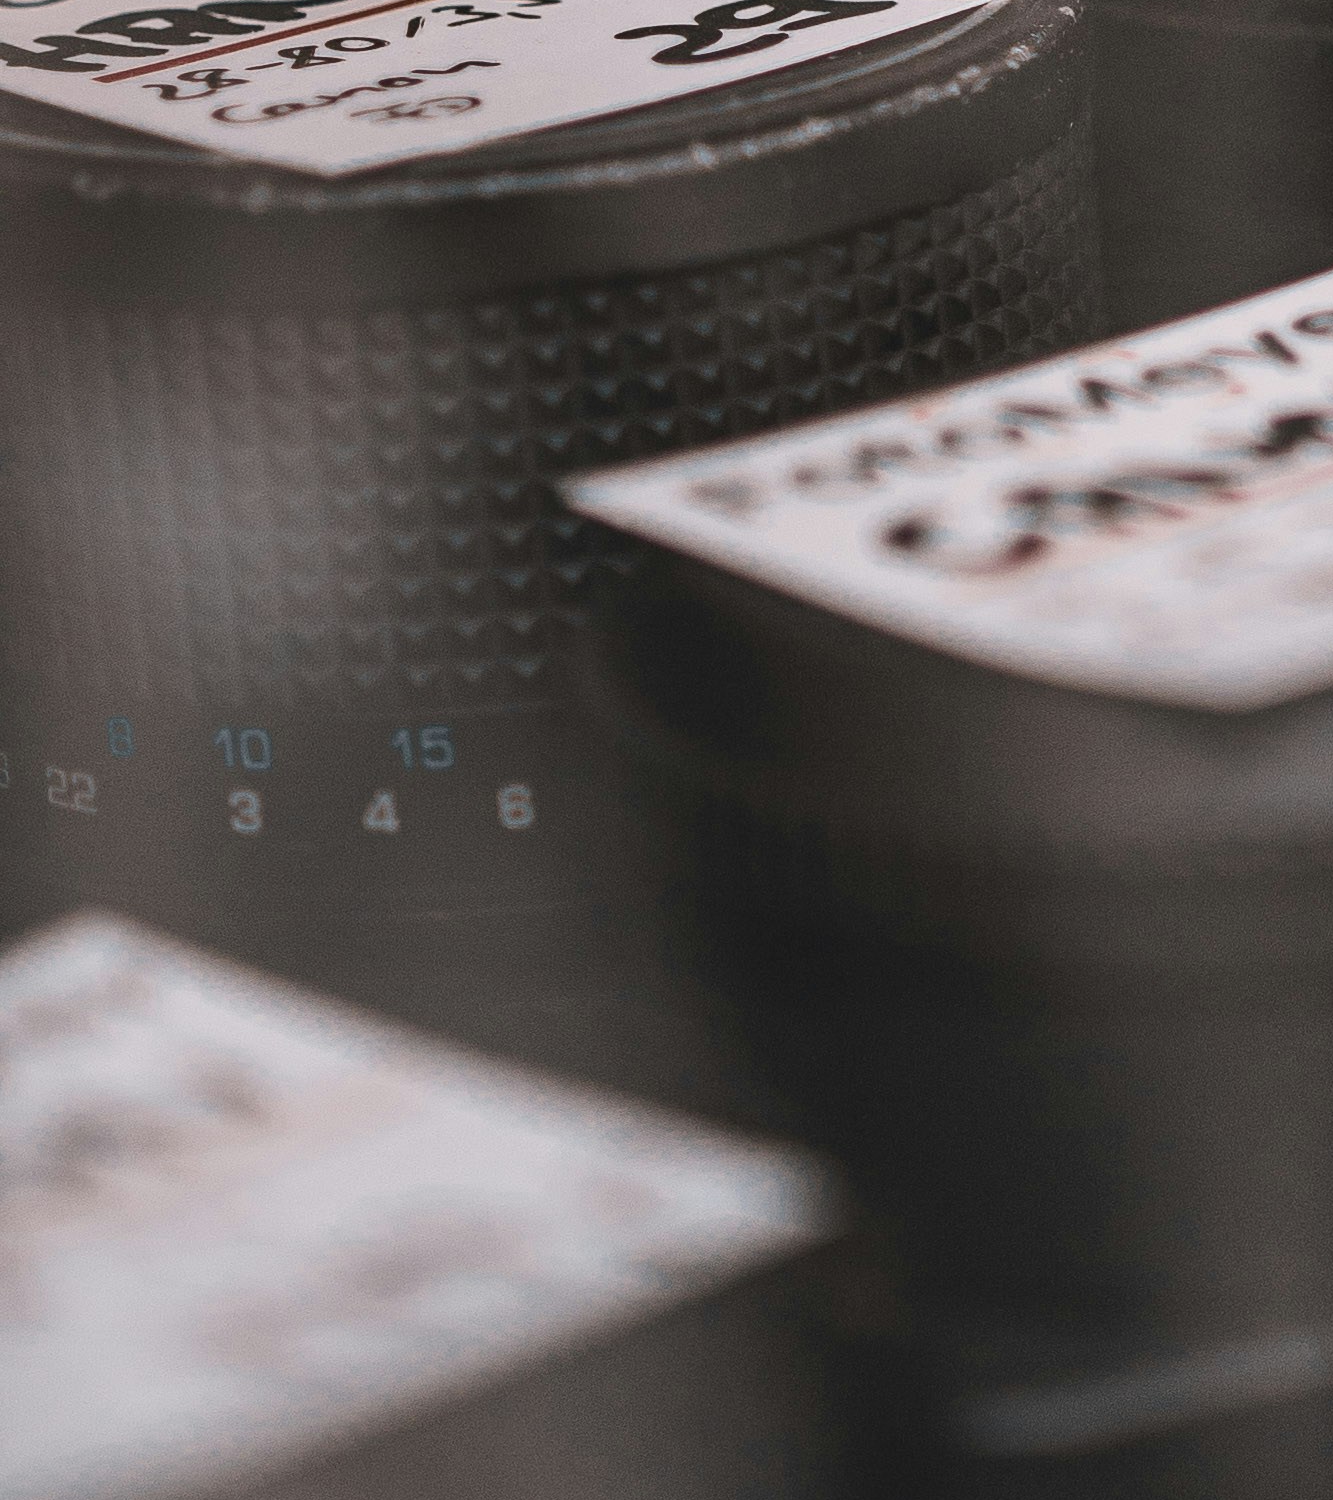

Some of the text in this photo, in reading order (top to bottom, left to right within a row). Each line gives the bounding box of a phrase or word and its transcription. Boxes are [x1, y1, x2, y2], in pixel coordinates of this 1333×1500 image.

[210, 60, 502, 124] Canon
[214, 727, 272, 770] 10
[391, 725, 455, 769] 15
[46, 765, 98, 816] 22
[229, 790, 262, 833] 3
[363, 790, 399, 832] 4
